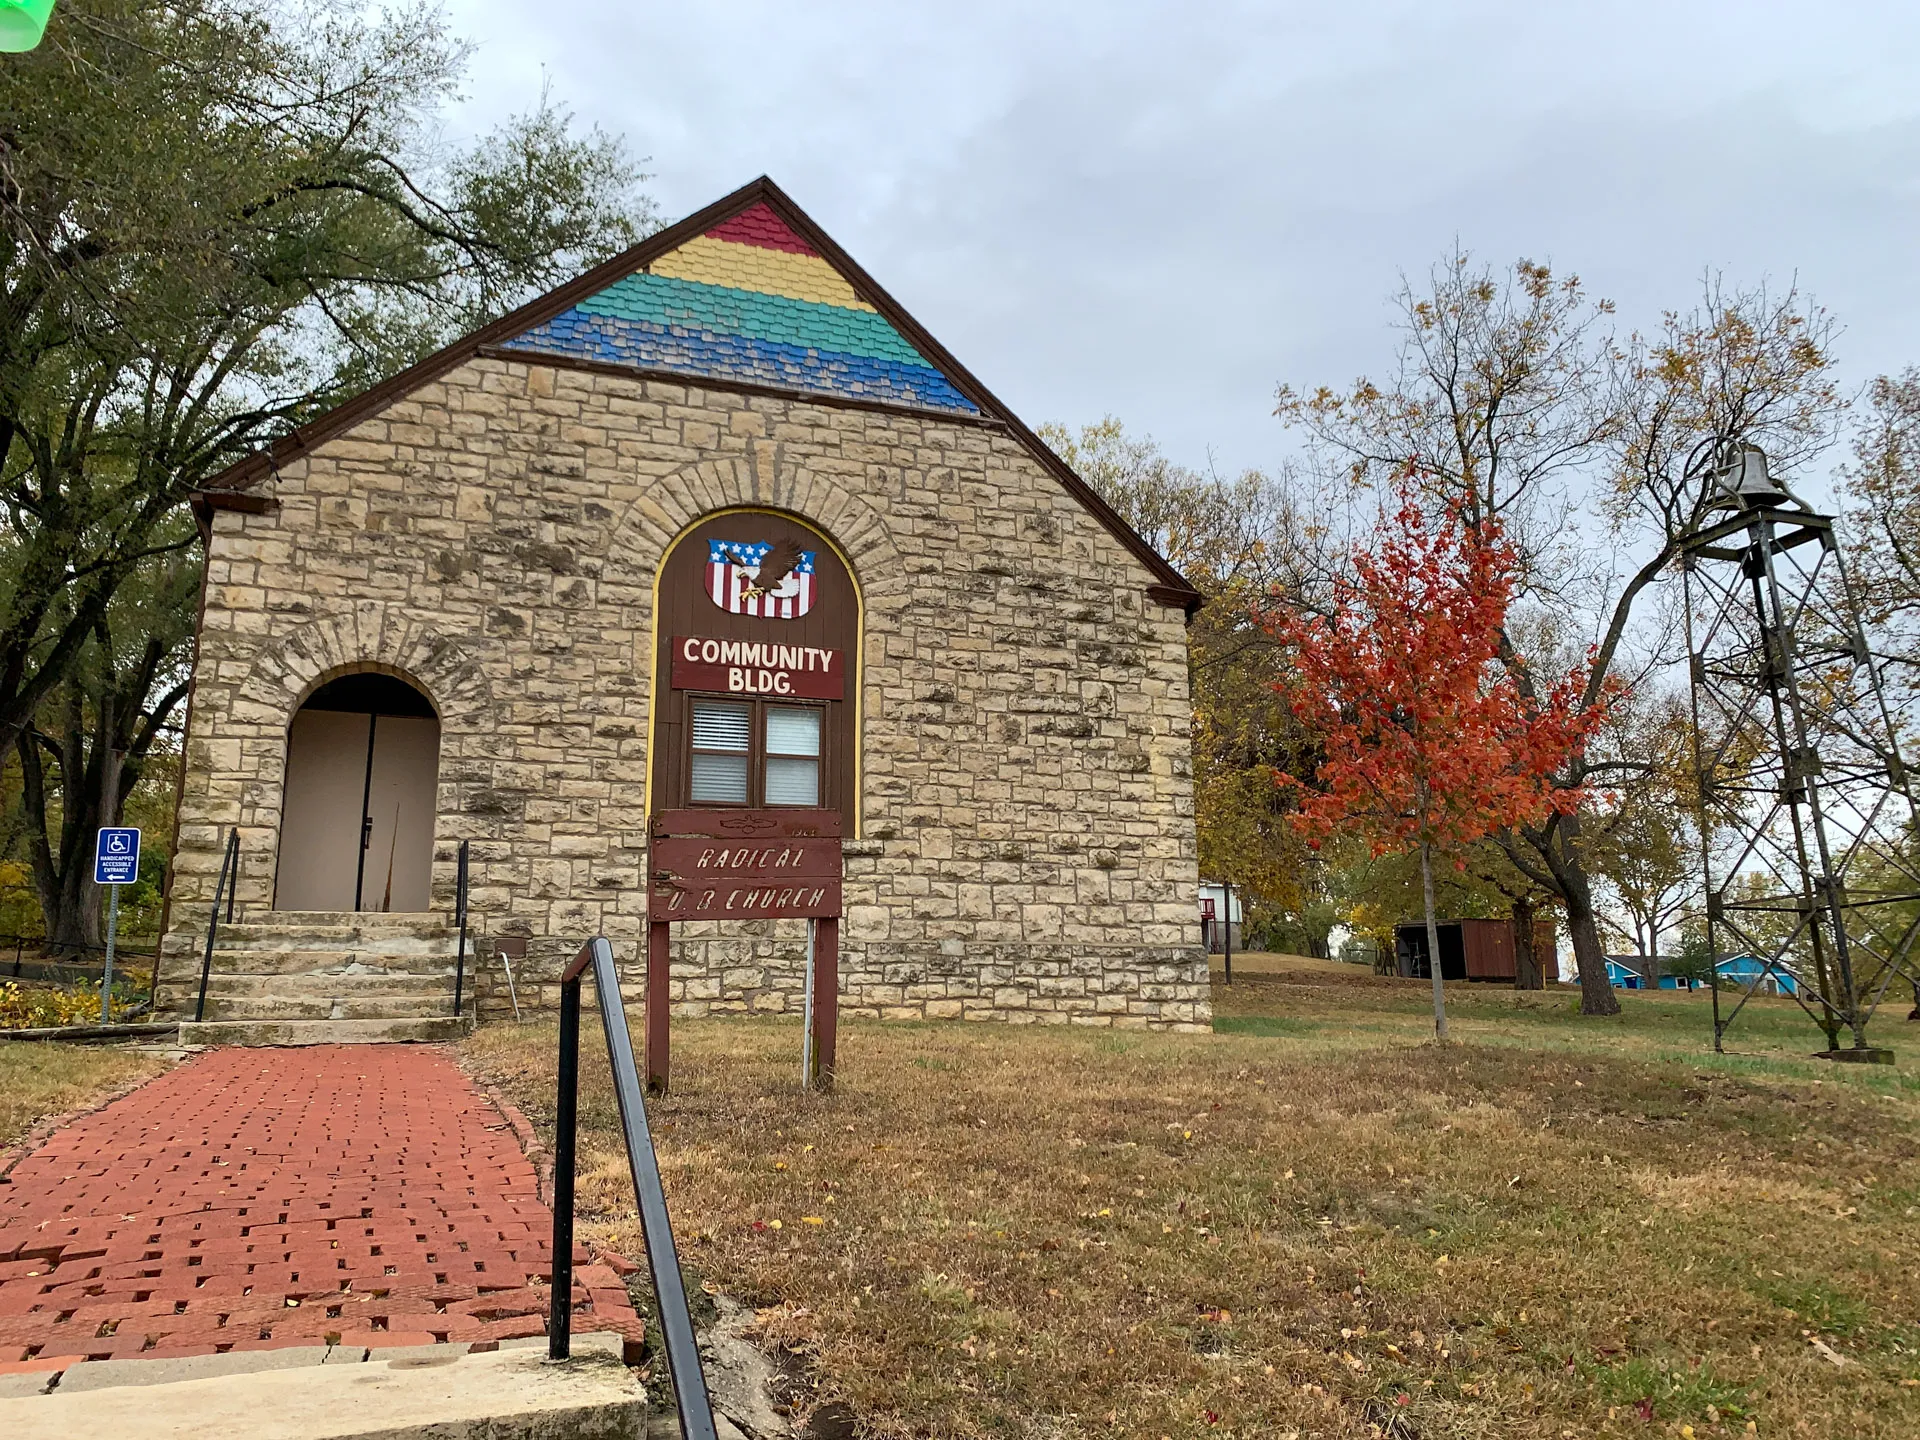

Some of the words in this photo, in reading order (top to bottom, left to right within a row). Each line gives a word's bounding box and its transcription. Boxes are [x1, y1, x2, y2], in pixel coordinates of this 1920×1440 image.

[683, 638, 833, 672] COMMUNITY
[728, 667, 796, 694] BLDG.
[696, 848, 804, 868] RADICAL
[725, 887, 825, 910] CHURCH
